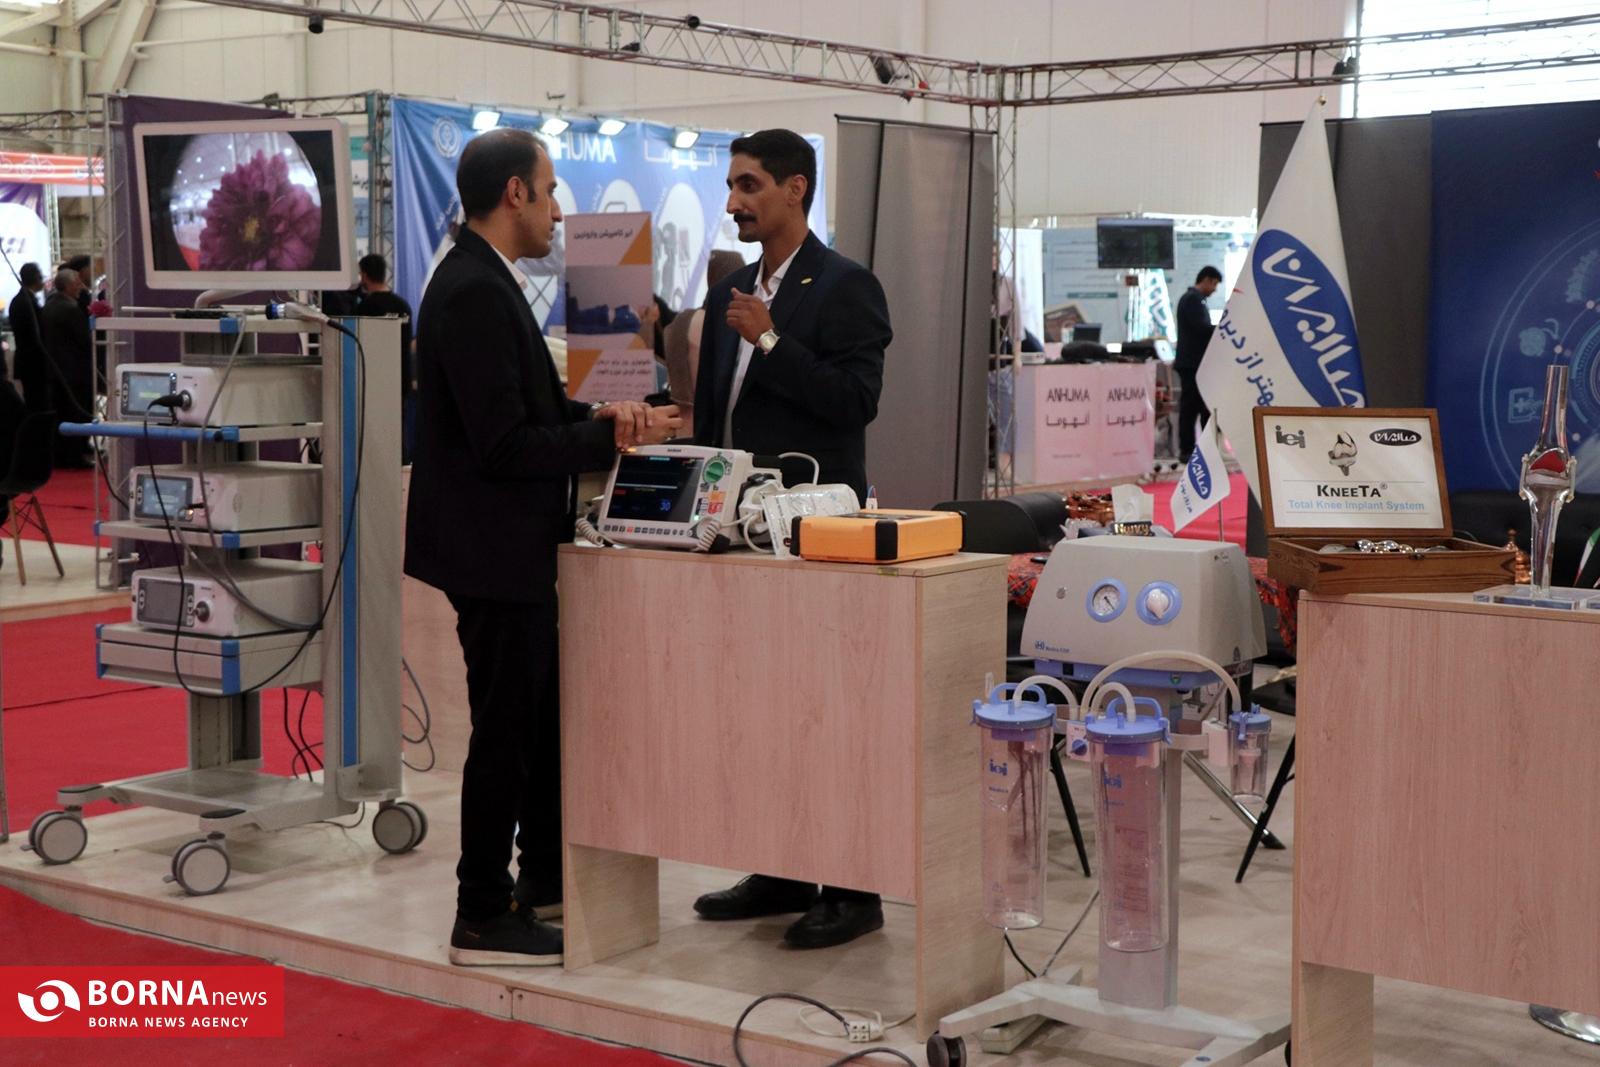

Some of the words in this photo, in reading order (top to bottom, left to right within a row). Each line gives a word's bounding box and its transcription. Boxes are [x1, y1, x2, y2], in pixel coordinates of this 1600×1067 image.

[549, 132, 617, 163] HUMA
[1235, 352, 1264, 369] از
[1046, 387, 1090, 402] ANHUMA
[1107, 387, 1147, 402] ANHUMA
[1246, 375, 1274, 407] هتر
[1288, 500, 1313, 510] Total
[1316, 500, 1342, 510] Knee
[1345, 500, 1384, 512] Implant
[1386, 500, 1425, 512] System
